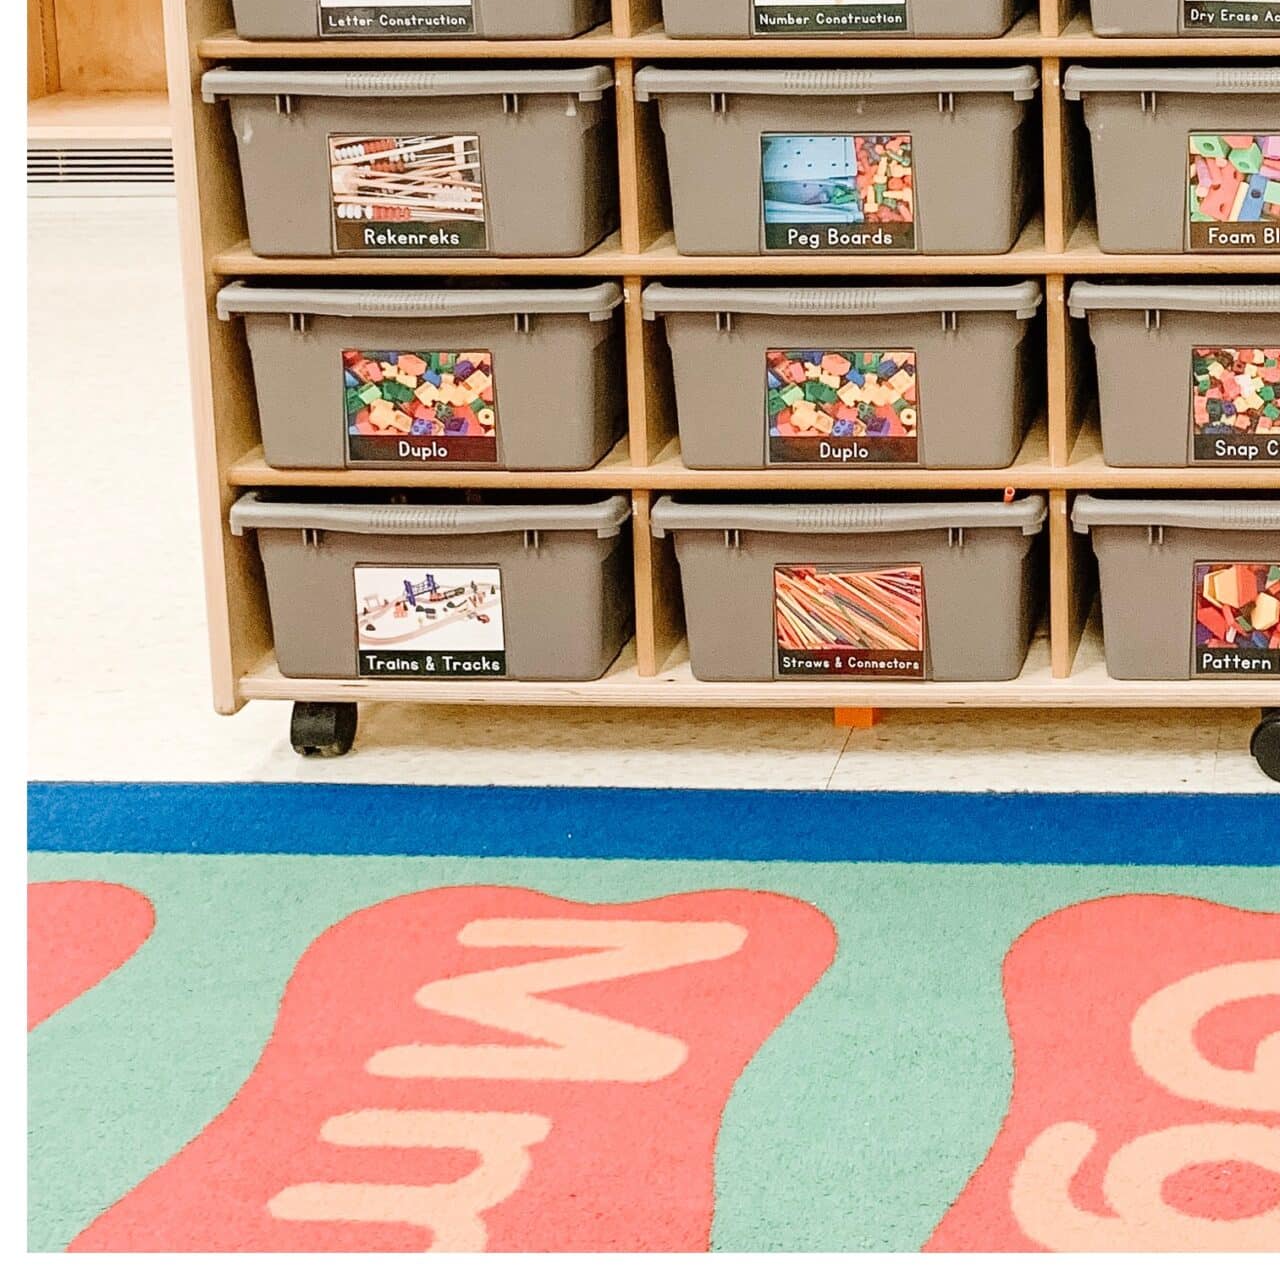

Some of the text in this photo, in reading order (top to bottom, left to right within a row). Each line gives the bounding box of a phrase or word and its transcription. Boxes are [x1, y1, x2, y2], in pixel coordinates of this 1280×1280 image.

[328, 13, 466, 28] Letter Construction
[759, 11, 903, 26] Number Construction
[1190, 8, 1215, 23] Dry
[1220, 7, 1259, 23] Erase
[364, 228, 460, 245] Rekenreks
[788, 227, 893, 249] Peg Boards
[1208, 227, 1256, 244] Foam
[399, 440, 448, 460] Duplo
[819, 441, 869, 462] Duplo
[1215, 439, 1259, 460] Snap
[365, 655, 500, 671] Trains & Tracks
[783, 655, 920, 671] Straws & Connectors
[1202, 653, 1272, 670] Pattern
